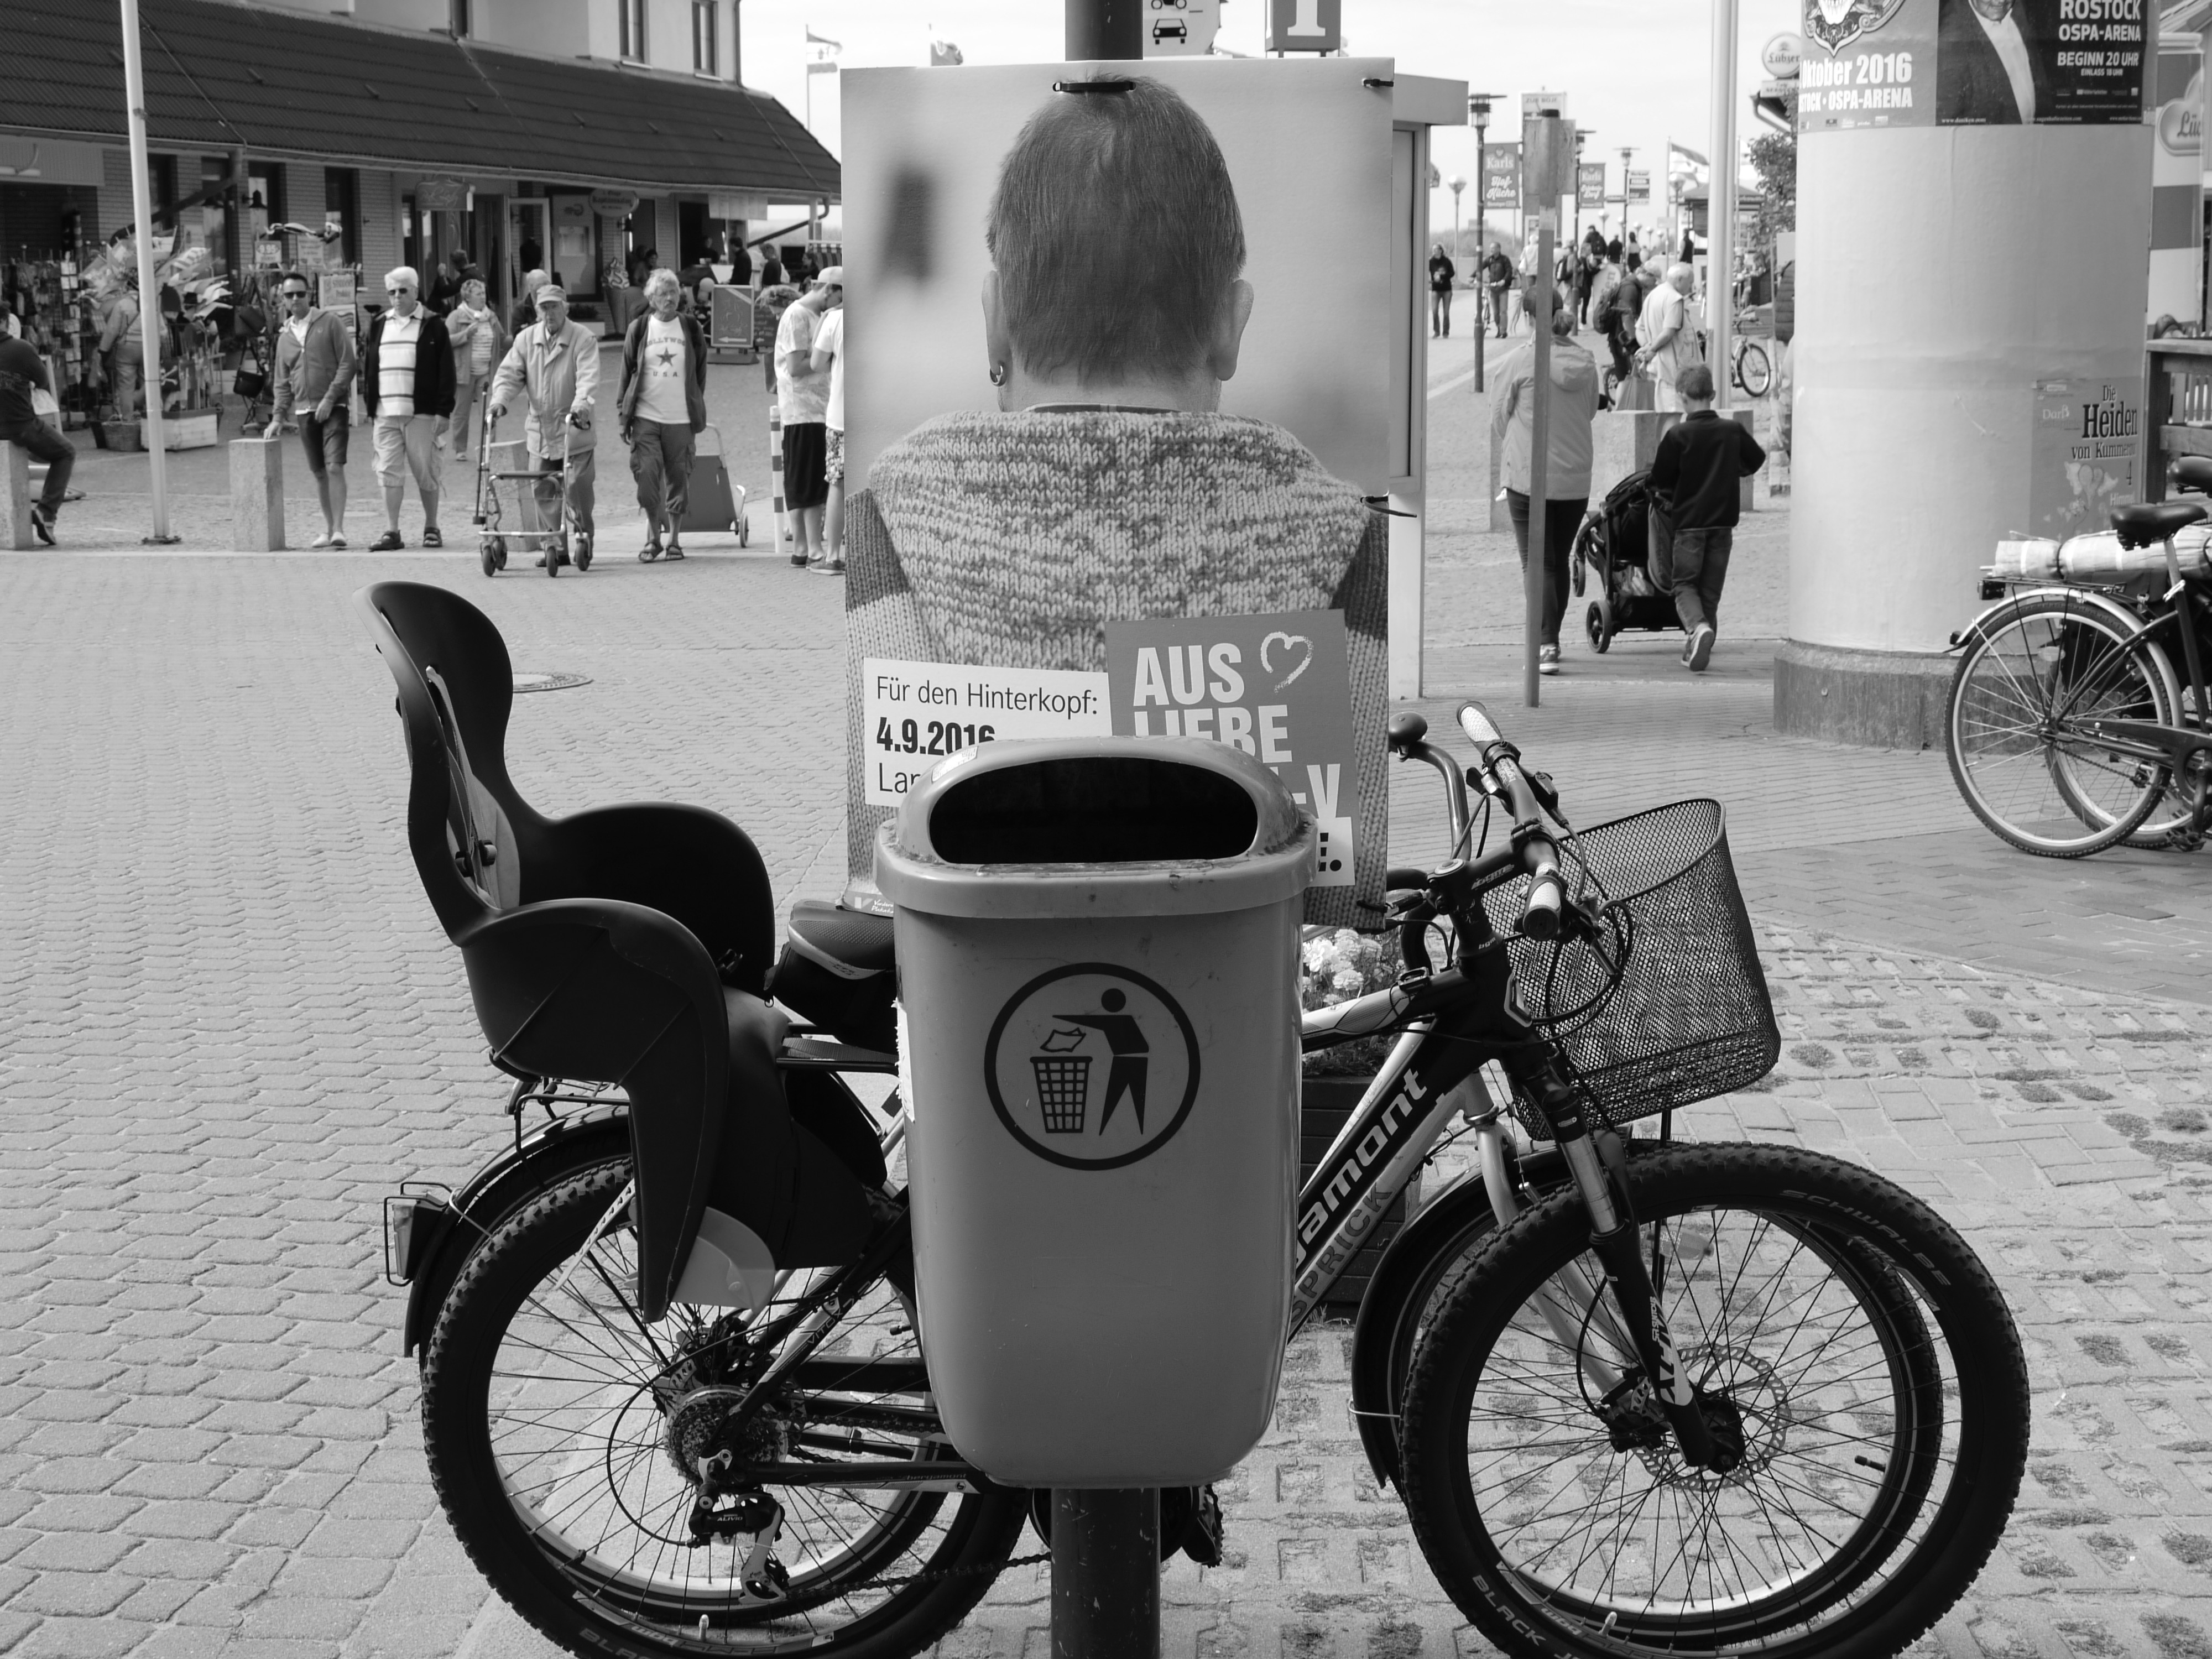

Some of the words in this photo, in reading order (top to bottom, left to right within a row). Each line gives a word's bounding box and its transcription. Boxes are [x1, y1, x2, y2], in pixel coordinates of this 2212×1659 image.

[2060, 0, 2141, 20] ROSTOCK
[2058, 24, 2141, 41] OSPA-ARENA
[1855, 52, 1912, 84] 2016
[2057, 51, 2104, 66] BEGINN
[2106, 53, 2120, 66] 20
[2121, 52, 2139, 66] UHR
[1798, 92, 1822, 113] STOCK
[1828, 87, 1913, 111] OSPA-ARENA
[1486, 155, 1514, 169] Karls
[2103, 385, 2116, 401] Die
[2081, 401, 2138, 439] Heiden
[2072, 446, 2090, 459] von
[1133, 643, 1245, 706] AUS
[877, 676, 910, 702] Für
[917, 680, 957, 706] den
[968, 682, 1098, 720] Hinterkopf:
[1478, 937, 1496, 950] bgm
[1779, 1190, 1952, 1286] SCHWALBE
[1472, 1574, 1547, 1647] BLACK
[580, 1627, 653, 1659] BLA
